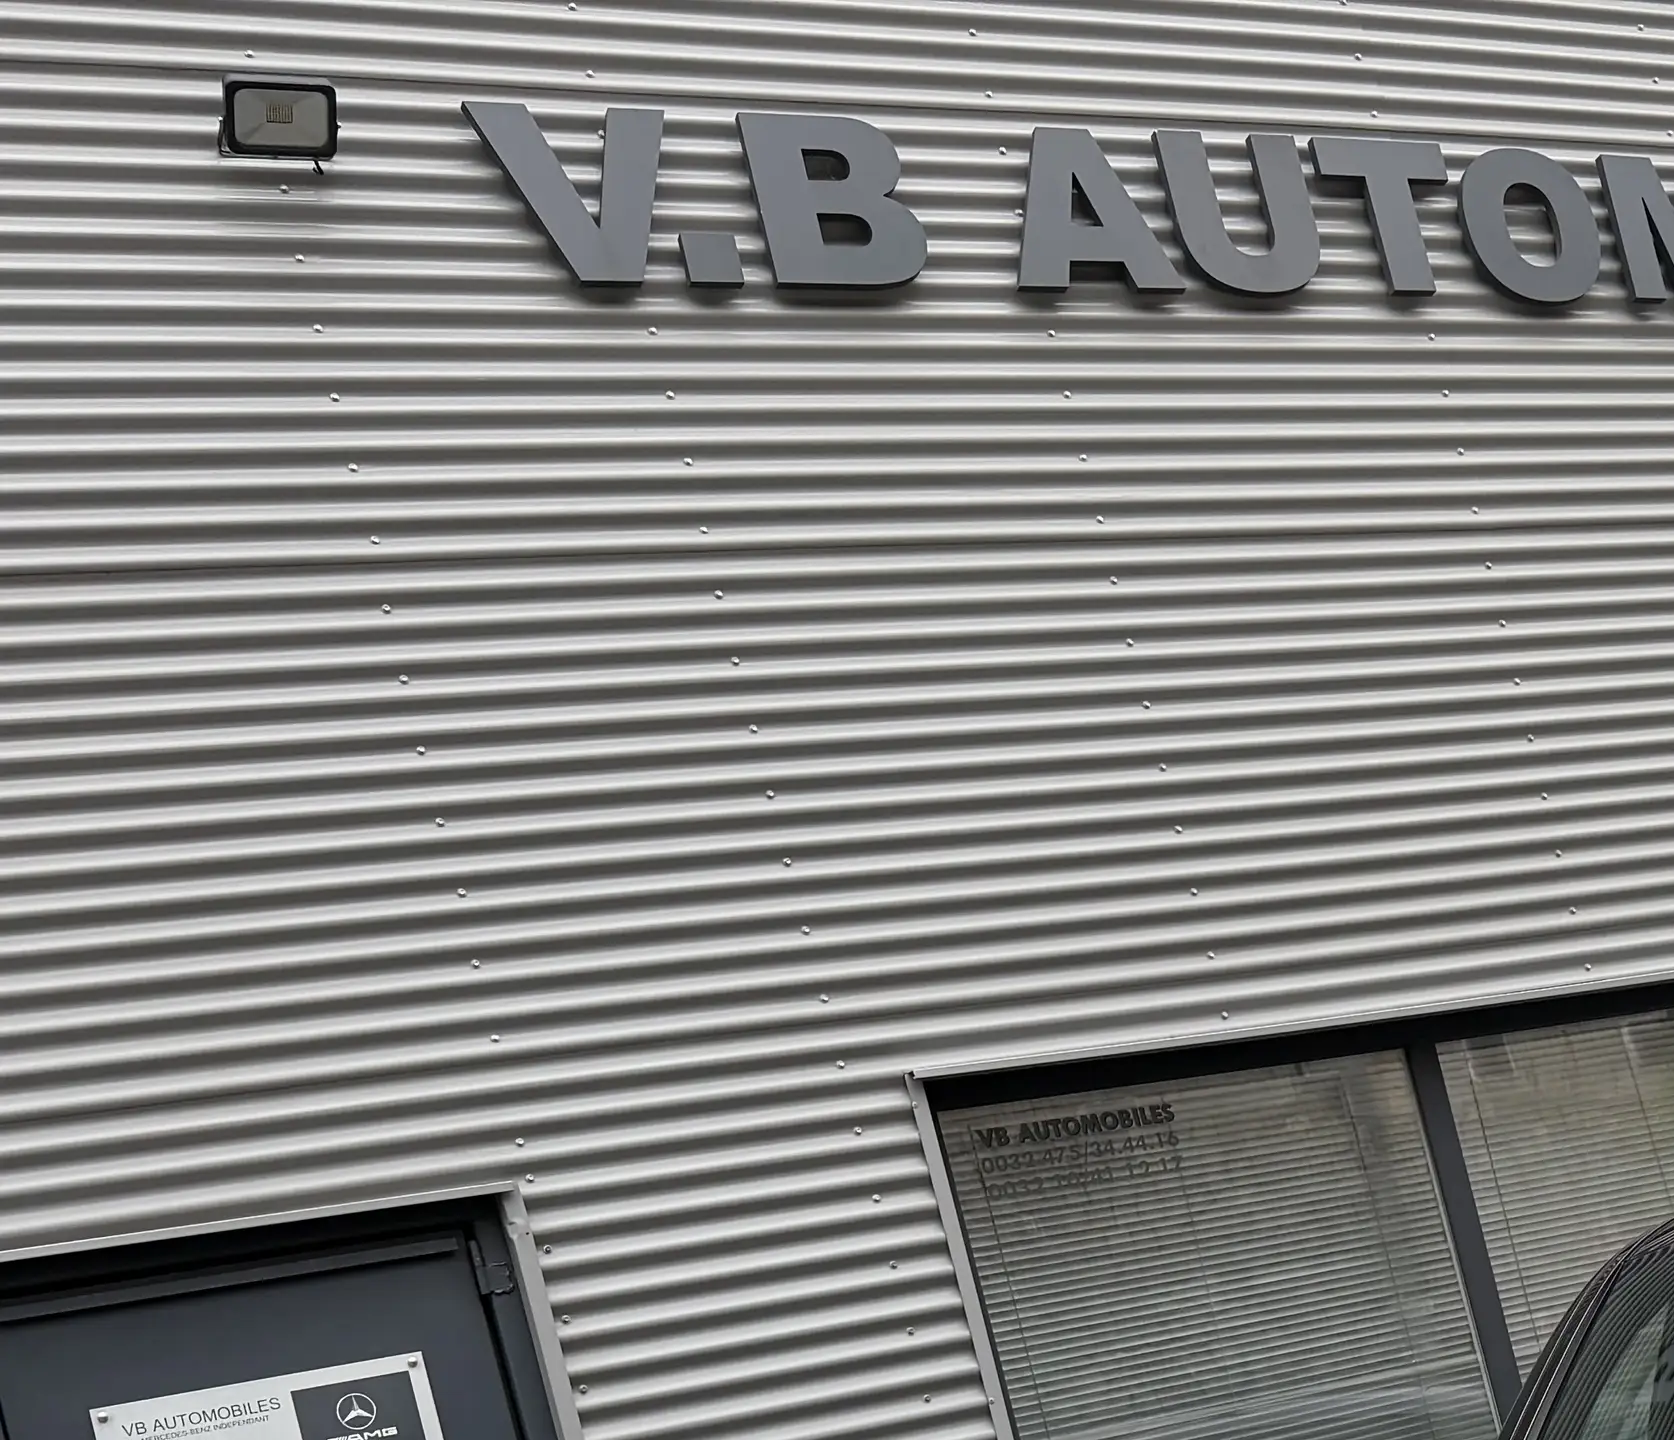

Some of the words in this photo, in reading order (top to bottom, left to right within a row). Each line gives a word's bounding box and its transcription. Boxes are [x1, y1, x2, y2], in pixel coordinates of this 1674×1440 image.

[461, 101, 928, 291] V.B
[975, 1126, 1011, 1148] VB
[1018, 1104, 1176, 1145] AUTOMOBILES
[980, 1150, 1035, 1174] 0032
[122, 1421, 147, 1437] VB
[153, 1397, 281, 1432] AUTOMOBILES
